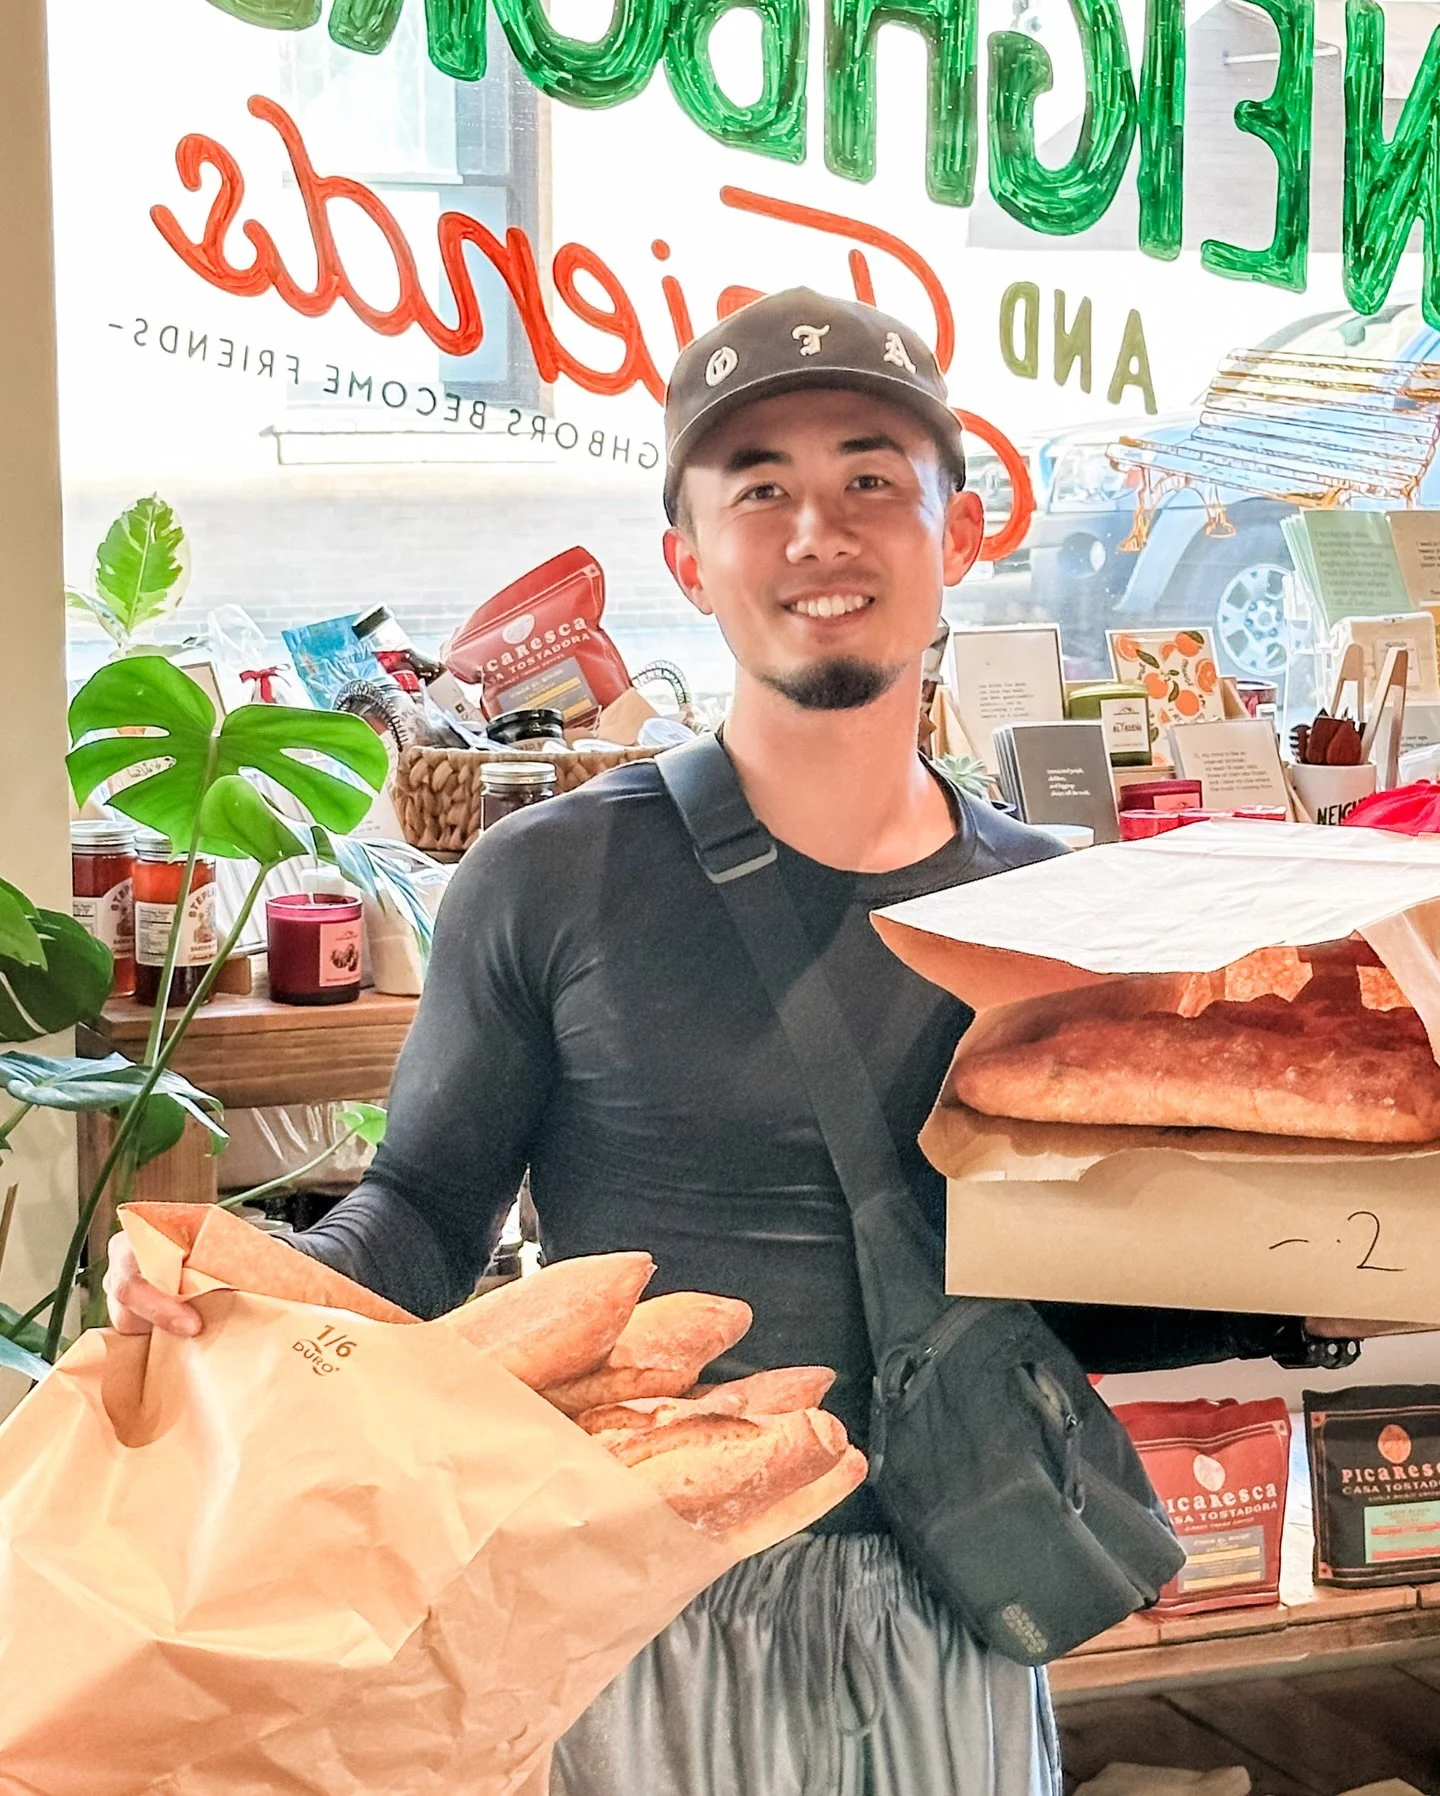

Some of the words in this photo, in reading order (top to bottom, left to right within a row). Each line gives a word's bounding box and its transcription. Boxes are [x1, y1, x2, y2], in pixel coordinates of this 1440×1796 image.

[509, 633, 591, 674] TOSTADORA
[1316, 798, 1366, 826] NEIG
[316, 1324, 358, 1358] 1/6
[1341, 1484, 1380, 1496] CASA
[1384, 1479, 1440, 1493] TOSTAD
[1199, 1499, 1279, 1522] TOSTADORA
